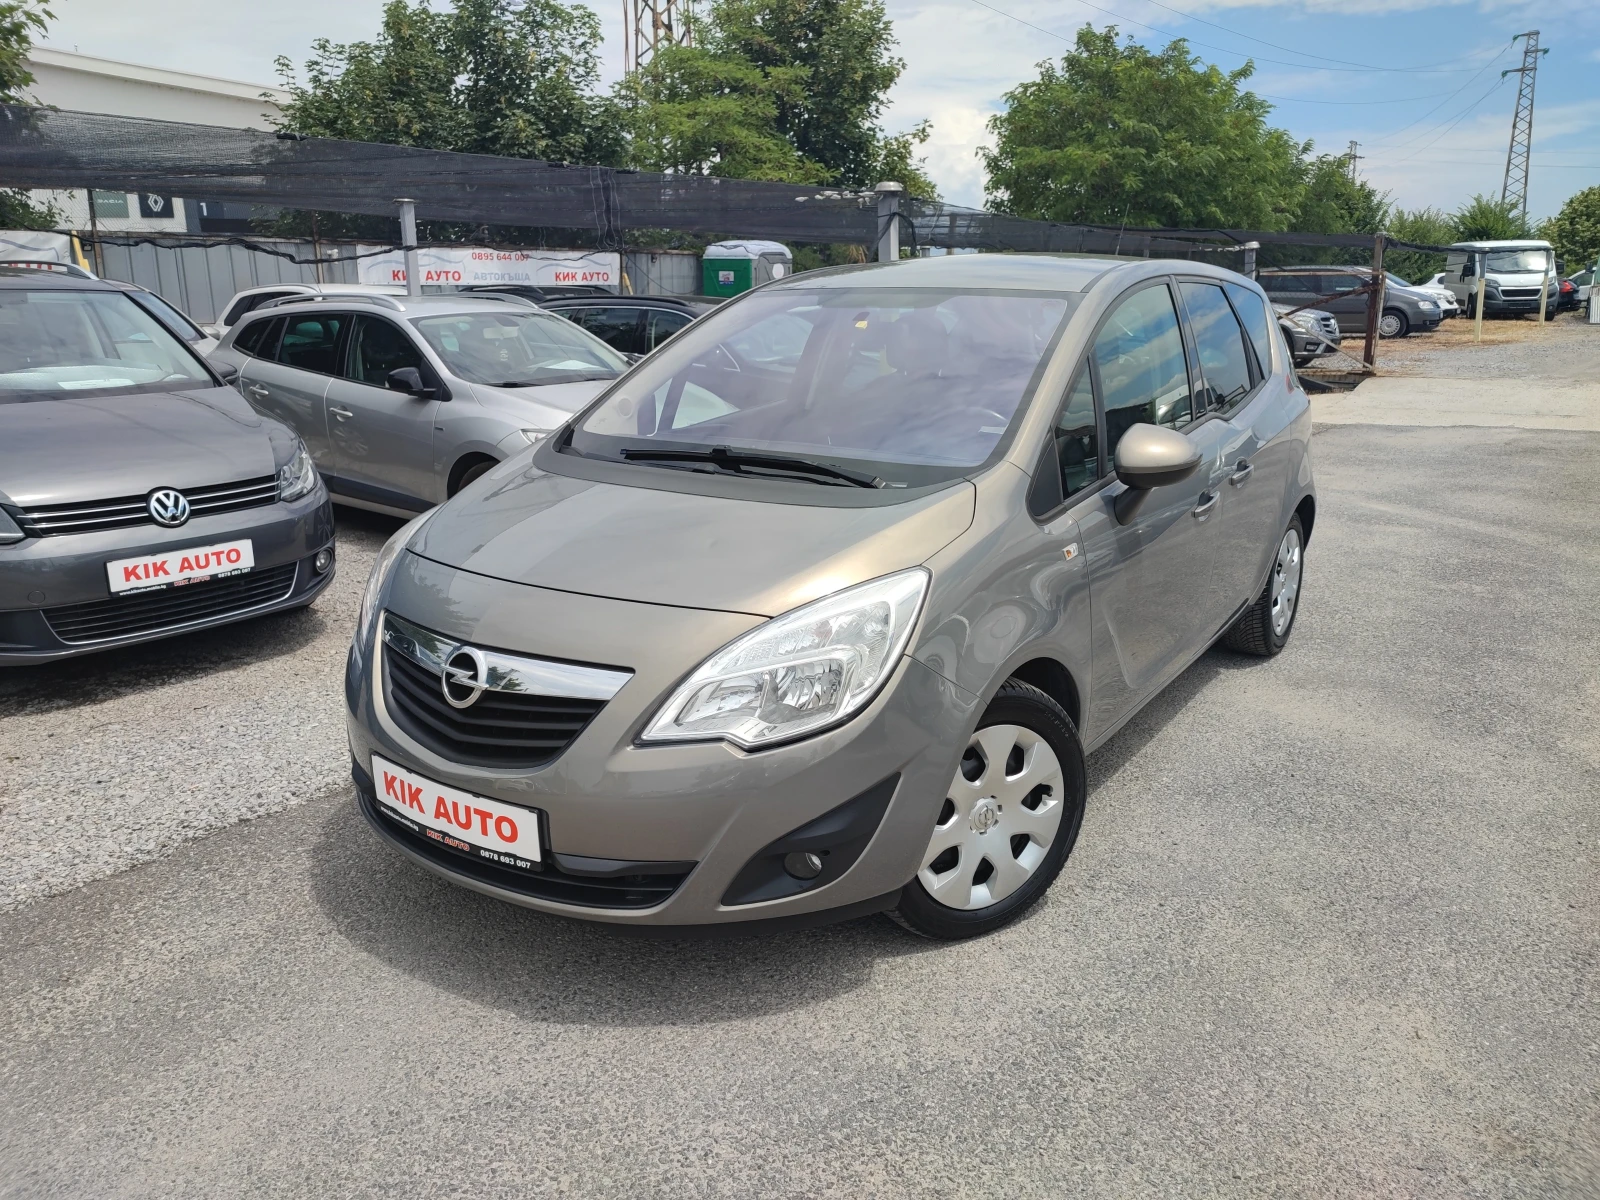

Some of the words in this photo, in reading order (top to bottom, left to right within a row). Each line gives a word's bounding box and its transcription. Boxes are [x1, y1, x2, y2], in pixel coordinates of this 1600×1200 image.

[471, 252, 494, 261] 0895
[496, 252, 512, 261] 644
[514, 252, 530, 262] 007
[425, 270, 462, 282] АУТО
[473, 272, 531, 282] АВТОКЪЩА
[555, 271, 578, 282] КИК
[581, 271, 610, 282] АУТО
[123, 560, 171, 583] KIK
[178, 548, 241, 573] AUTO
[383, 770, 426, 815] KIK
[433, 795, 519, 844] AUTO
[426, 828, 444, 843] KIK
[444, 836, 471, 852] AUTO
[480, 849, 499, 861] 0878
[500, 855, 515, 865] 693
[516, 859, 531, 869] 007
